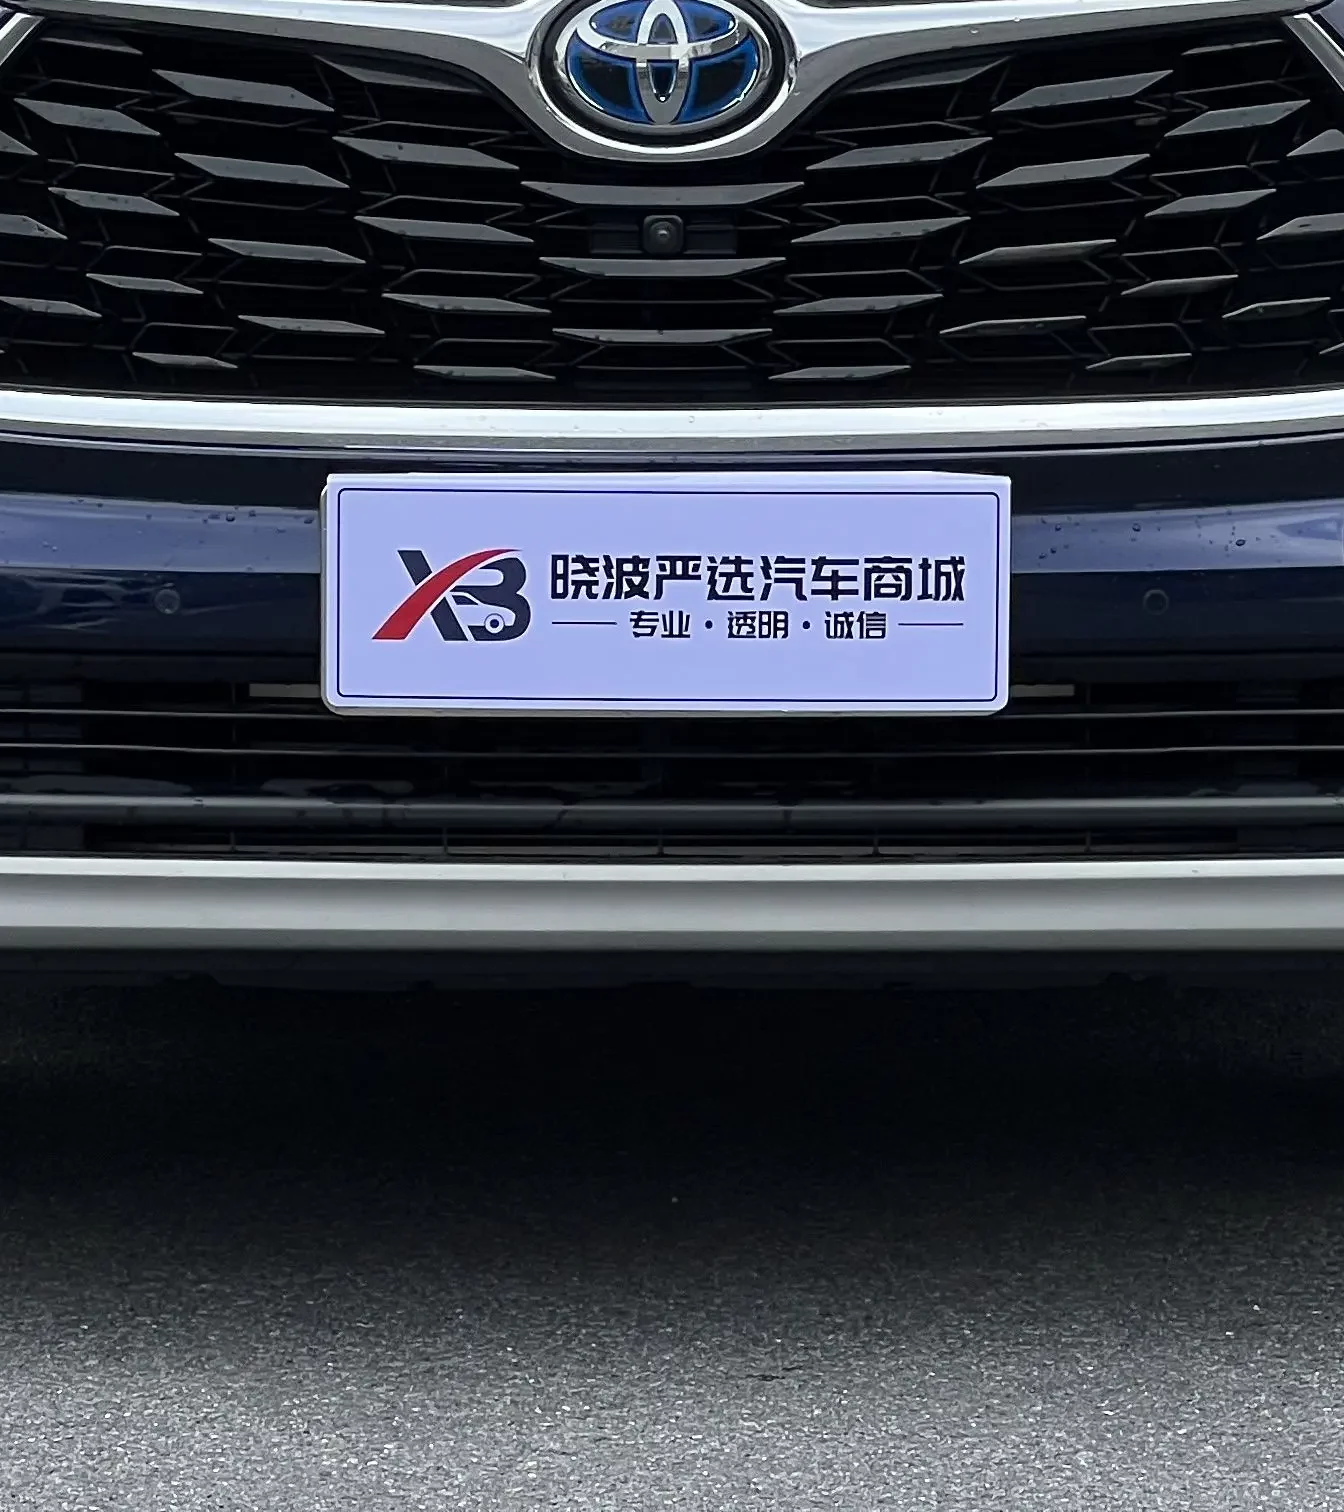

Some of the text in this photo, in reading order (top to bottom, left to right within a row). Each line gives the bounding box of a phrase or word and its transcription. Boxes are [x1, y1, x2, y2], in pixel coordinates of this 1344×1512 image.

[550, 553, 966, 602] 晓波严选汽车商城
